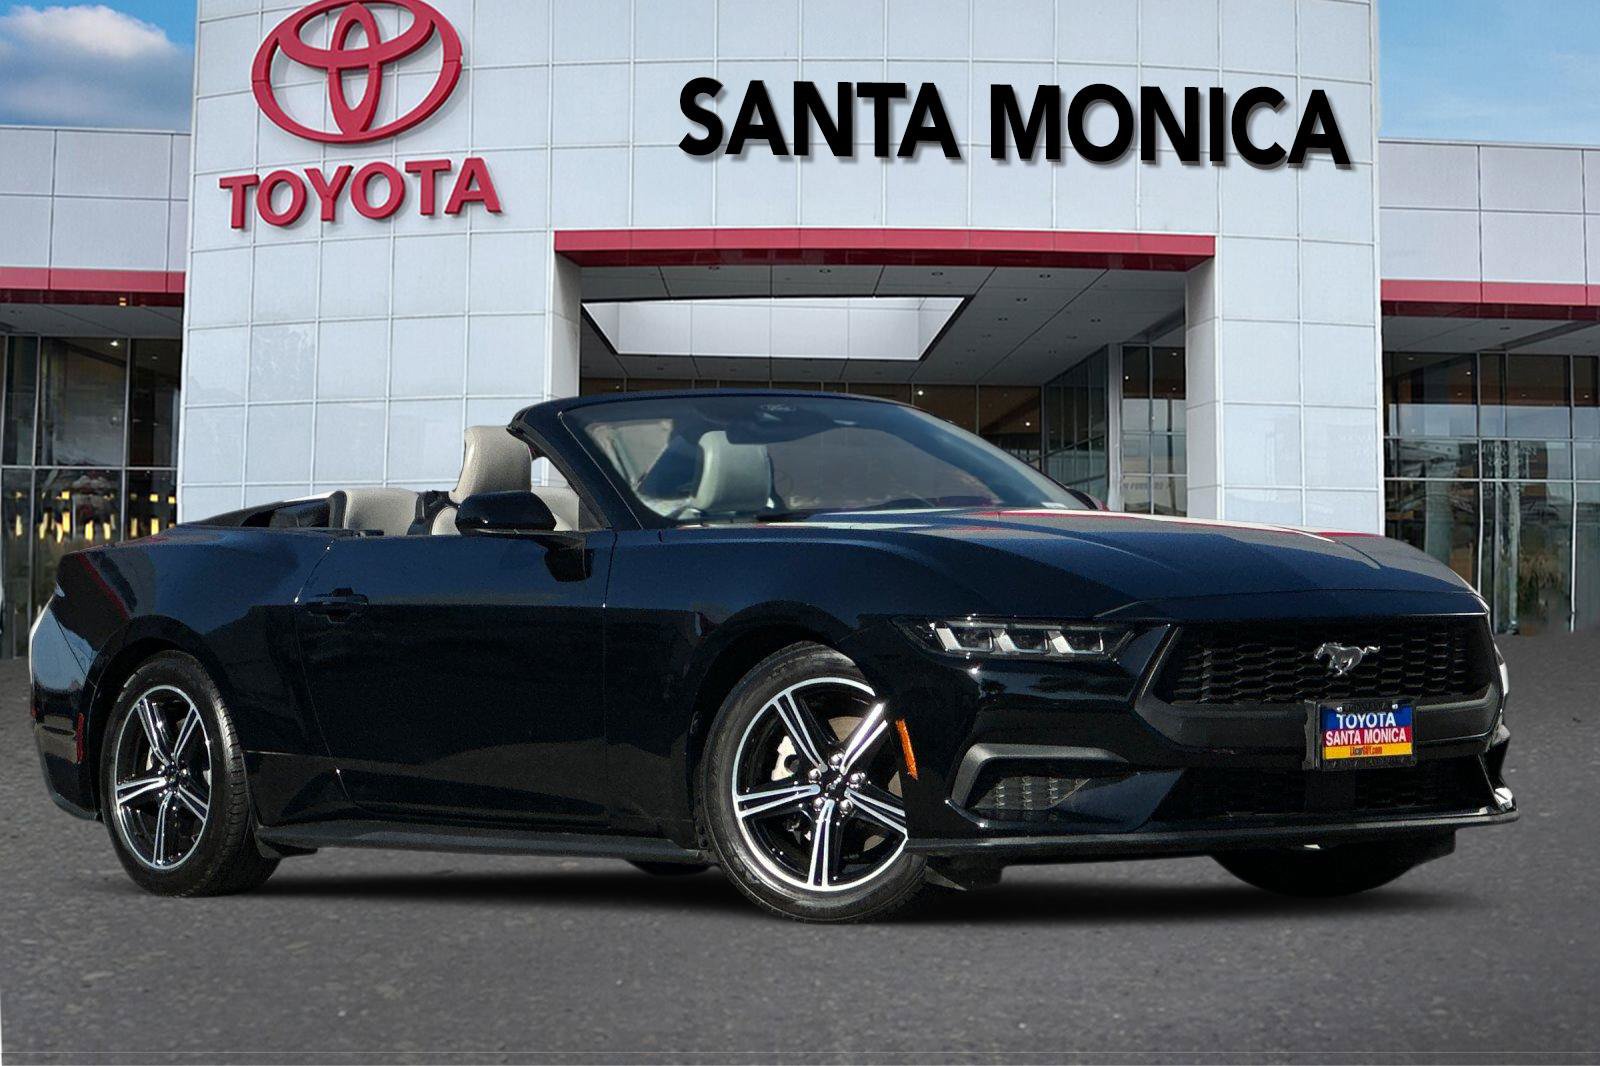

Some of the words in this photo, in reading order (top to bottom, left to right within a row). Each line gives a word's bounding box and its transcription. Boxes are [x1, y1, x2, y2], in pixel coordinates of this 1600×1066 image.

[679, 77, 961, 158] SANTA
[990, 83, 1351, 166] MONICA
[219, 157, 502, 229] TOYOTA
[1326, 730, 1361, 746] SANTA
[1364, 728, 1406, 744] MONICA
[1336, 712, 1396, 729] TOYOTA
